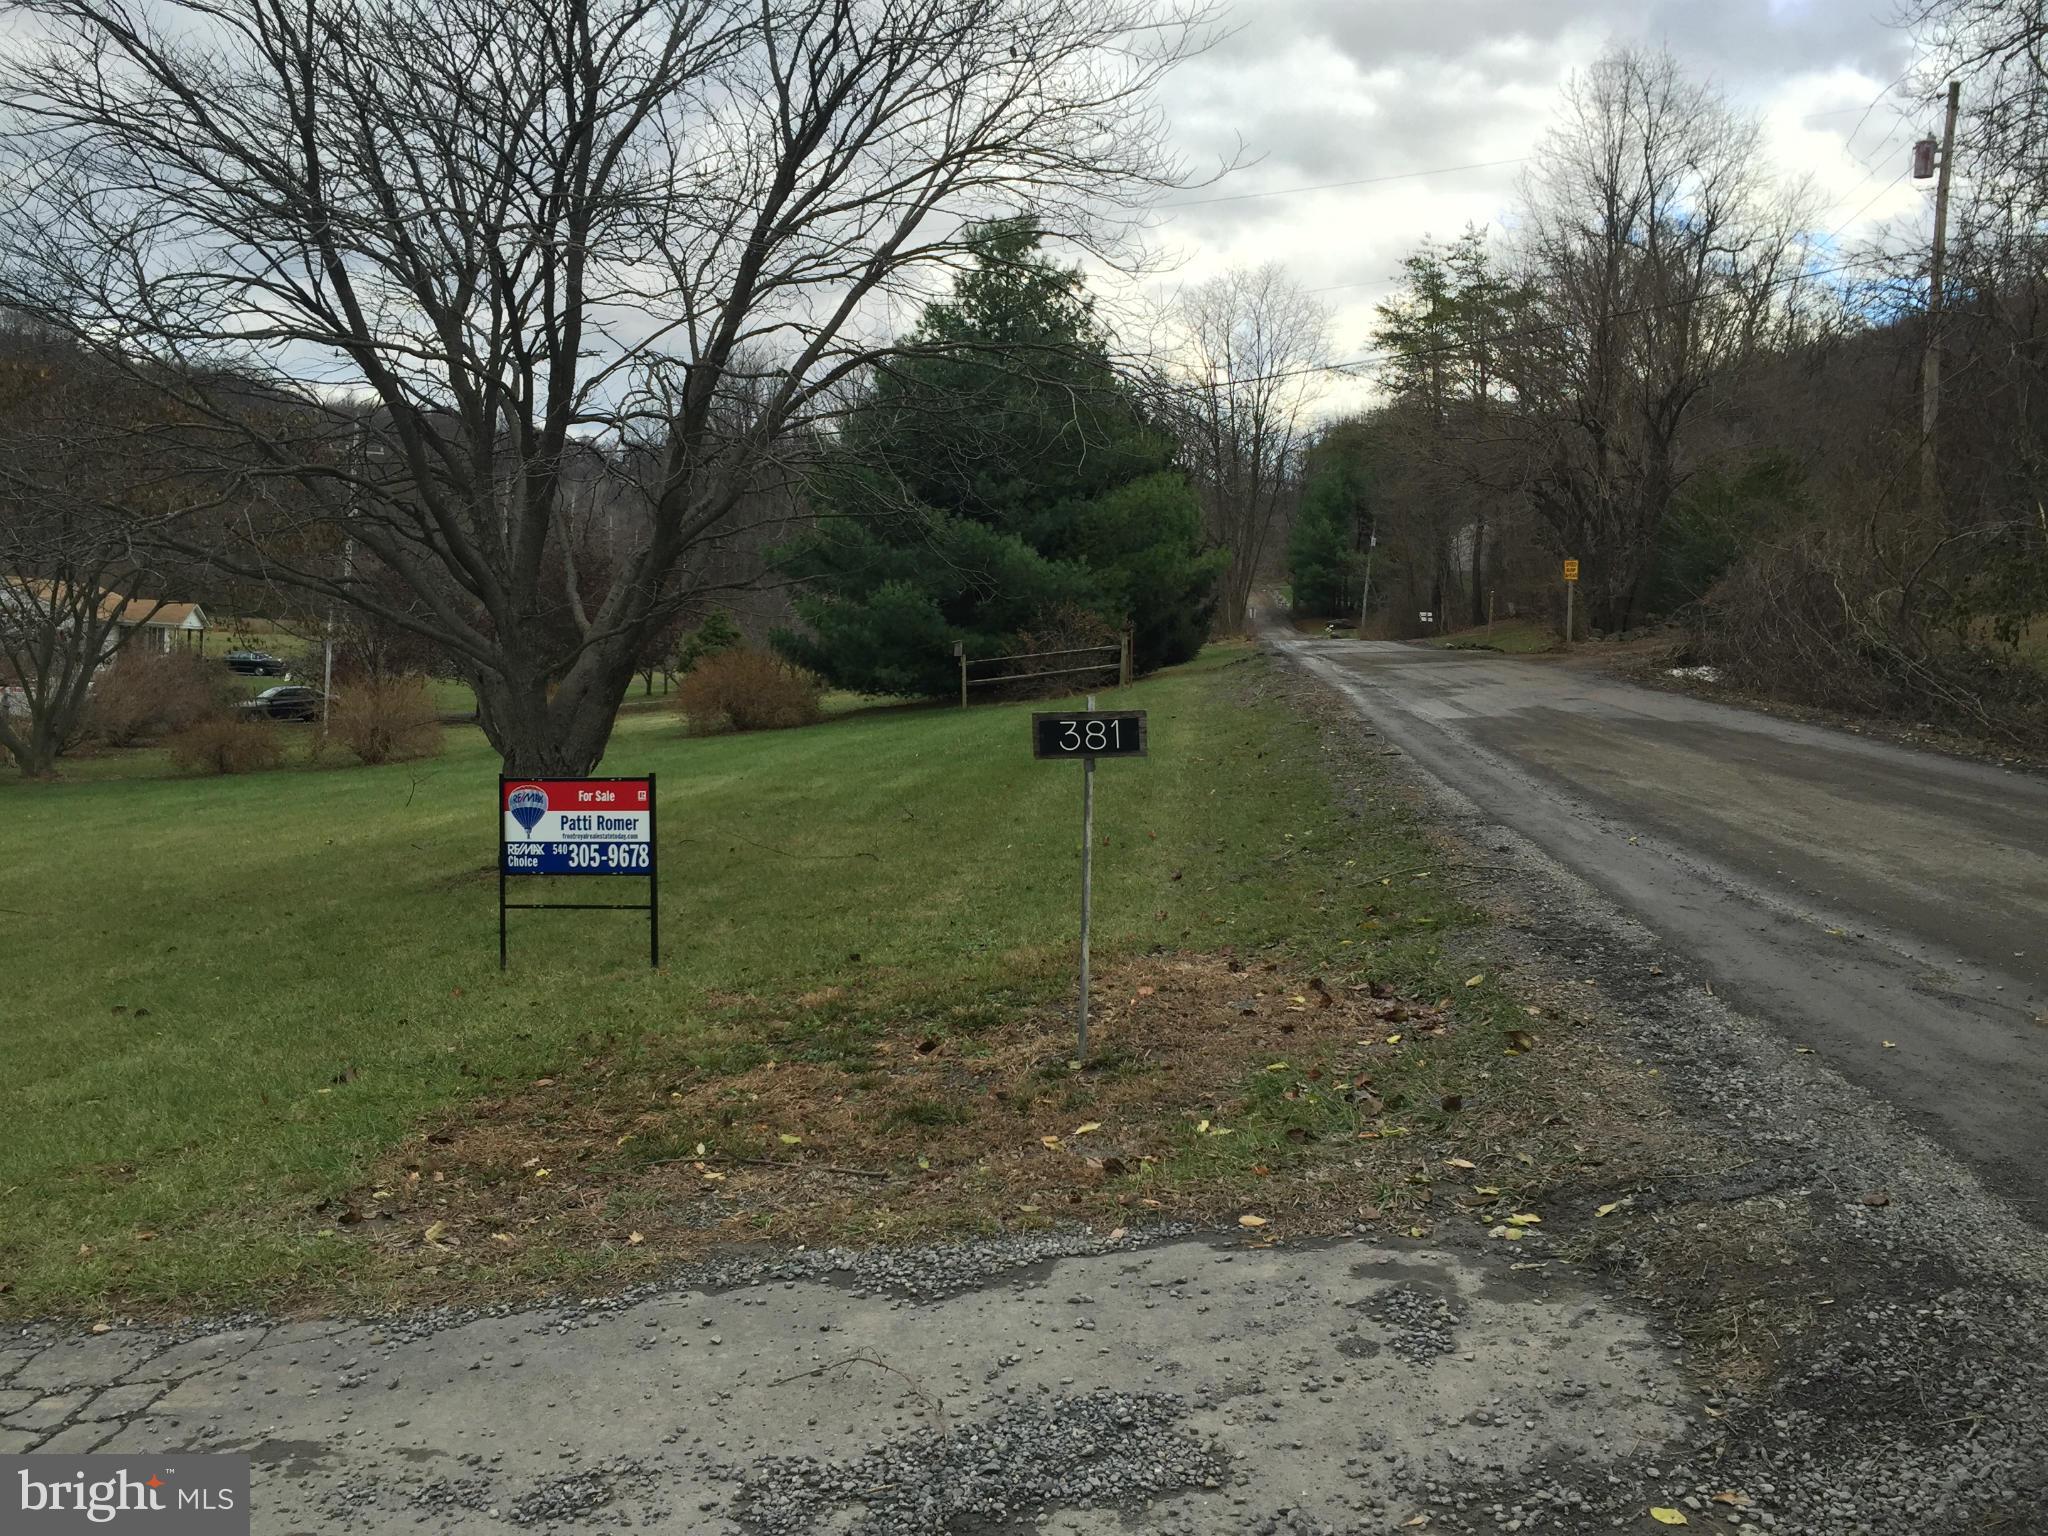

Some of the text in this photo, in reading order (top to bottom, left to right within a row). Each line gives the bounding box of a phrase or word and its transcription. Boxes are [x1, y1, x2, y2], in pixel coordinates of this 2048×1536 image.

[1059, 719, 1120, 751] 381
[578, 790, 615, 802] For Sale
[561, 815, 639, 831] Patti Romer
[507, 843, 545, 855] RE/MAX
[552, 844, 650, 867] 540 305-9678
[508, 855, 538, 867] Choice
